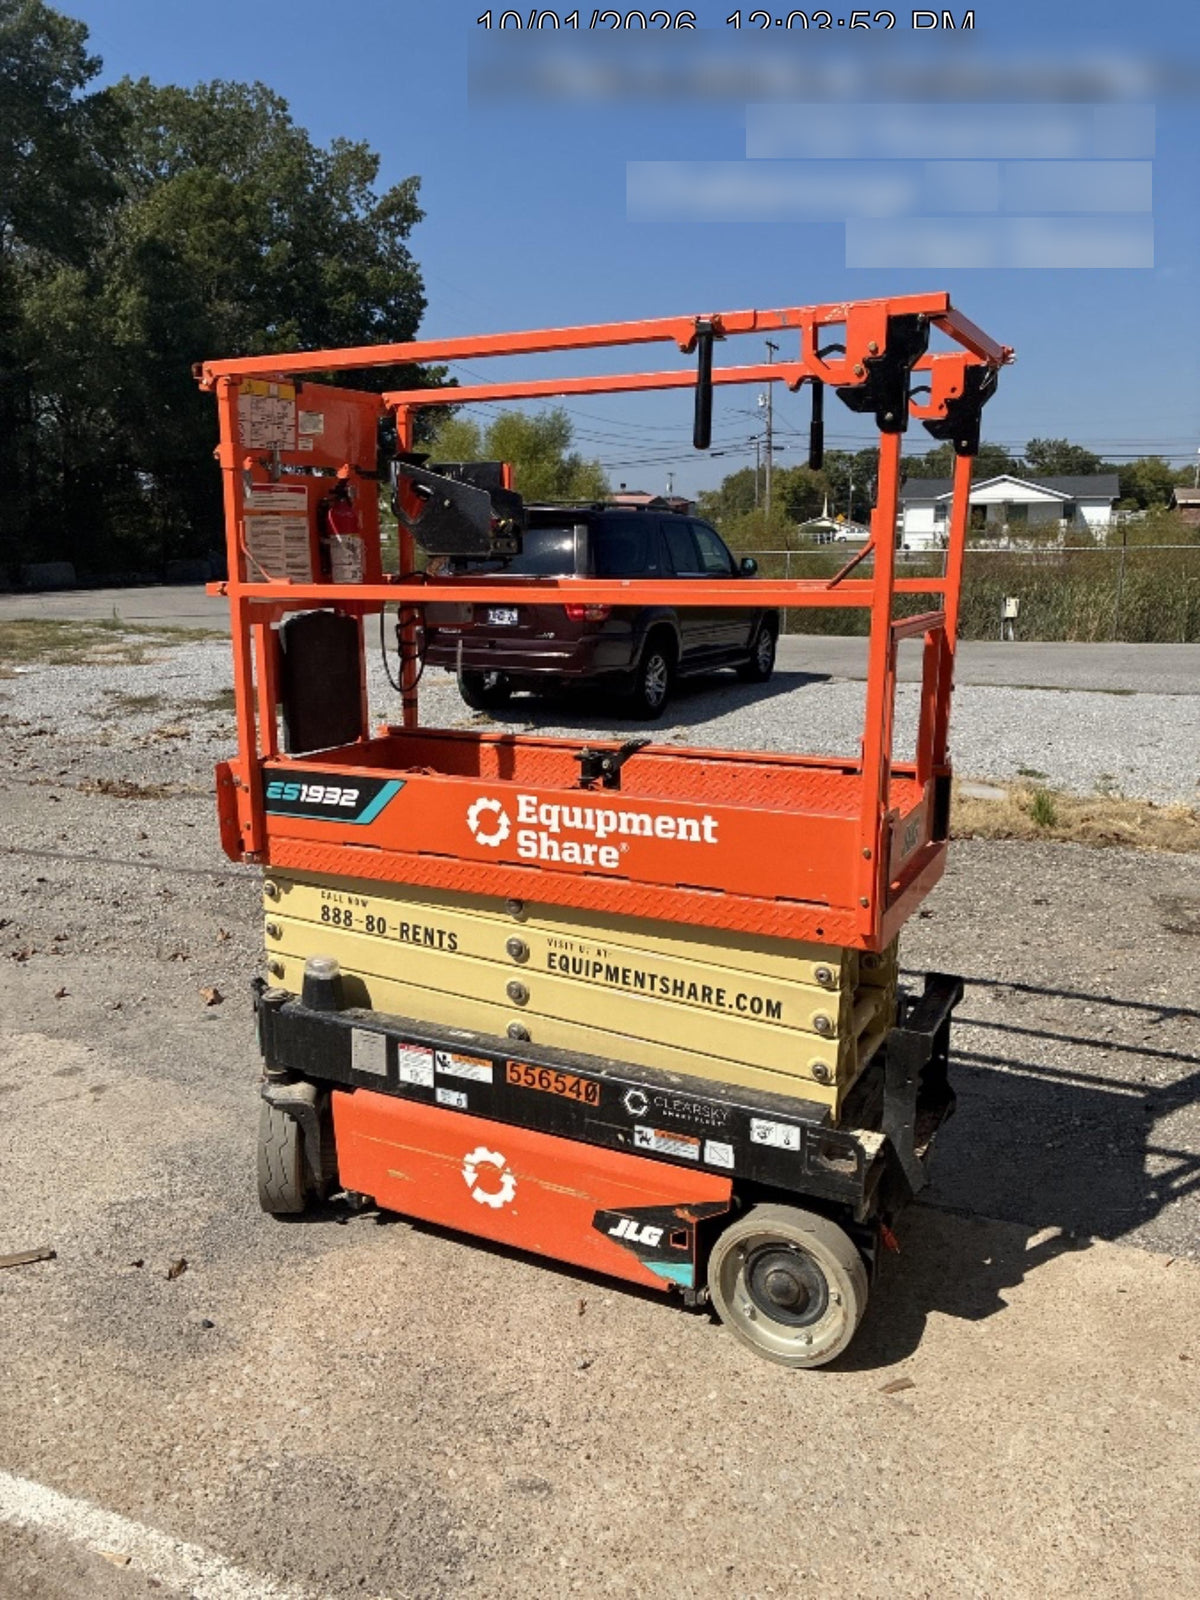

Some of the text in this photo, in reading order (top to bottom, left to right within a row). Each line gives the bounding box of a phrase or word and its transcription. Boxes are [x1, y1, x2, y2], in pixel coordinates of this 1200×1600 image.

[266, 781, 360, 808] ES1932
[516, 794, 719, 844] Equipment
[321, 890, 369, 908] CALL NOW
[547, 938, 574, 951] VISIT
[579, 945, 591, 955] U
[547, 952, 783, 1020] EQUIPMENTSHARE.COM
[509, 1062, 598, 1104] 556540
[608, 1218, 665, 1247] JLG
